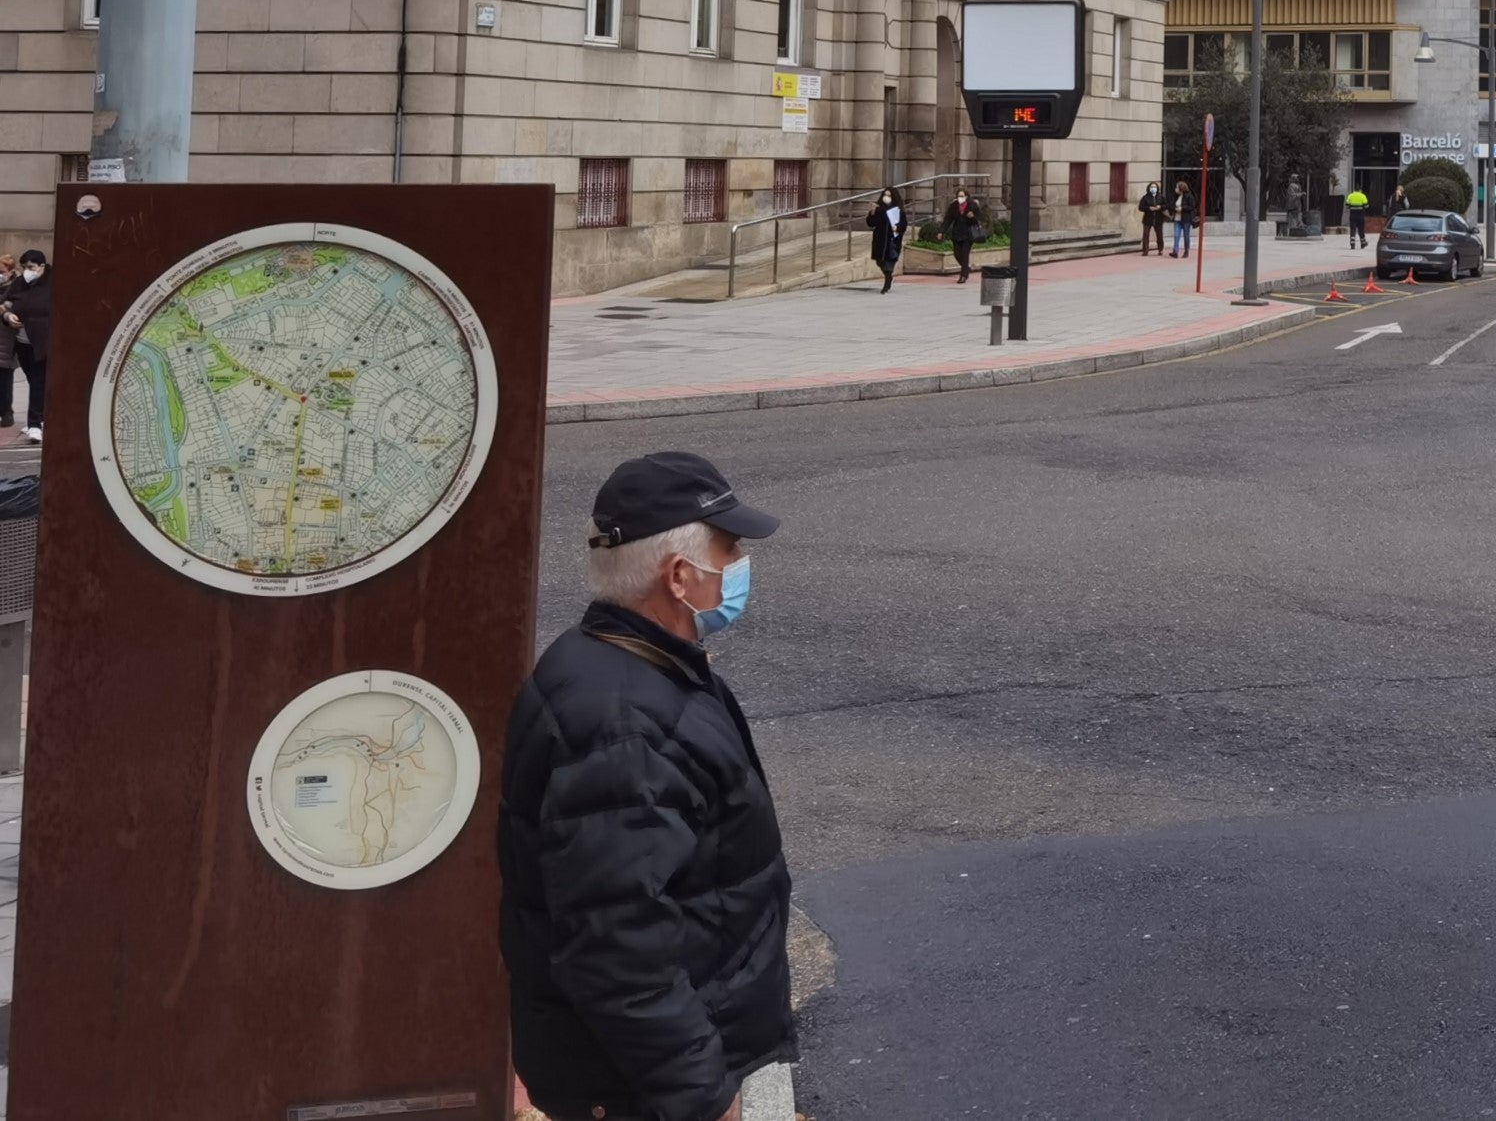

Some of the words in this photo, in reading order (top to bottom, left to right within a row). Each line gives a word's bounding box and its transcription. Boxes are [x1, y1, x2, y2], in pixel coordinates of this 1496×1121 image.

[1402, 133, 1461, 148] Barceló
[425, 692, 448, 712] CAPITAL
[447, 711, 463, 734] TERMAL
